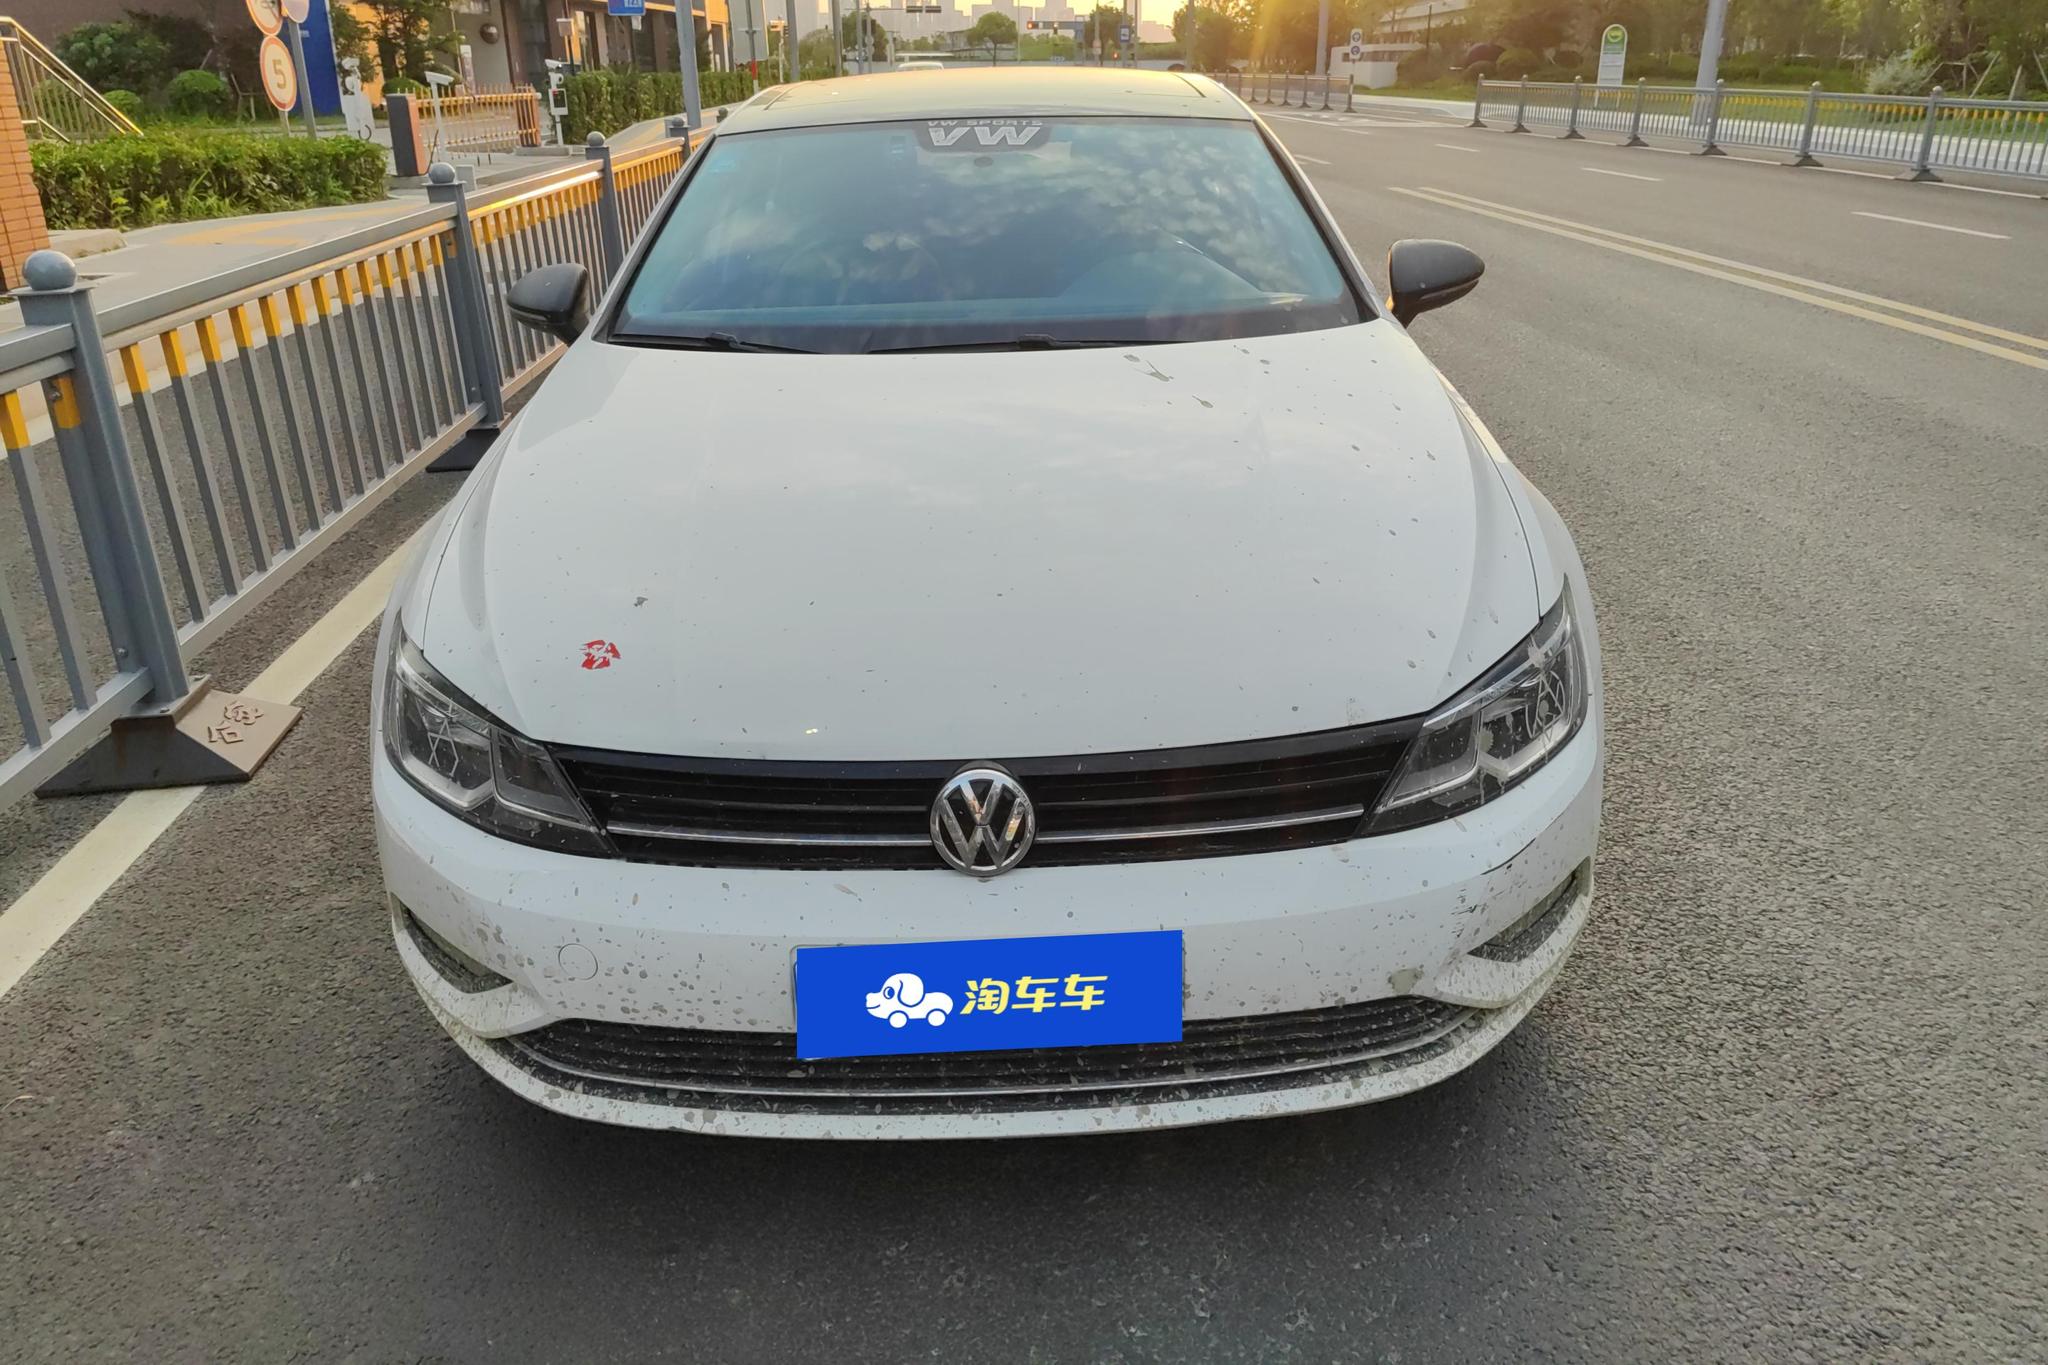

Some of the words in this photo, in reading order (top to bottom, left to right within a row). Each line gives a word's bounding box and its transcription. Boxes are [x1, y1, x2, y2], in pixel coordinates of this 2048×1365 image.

[272, 59, 286, 89] 5
[928, 126, 1041, 146] VW
[932, 770, 1034, 874] VW
